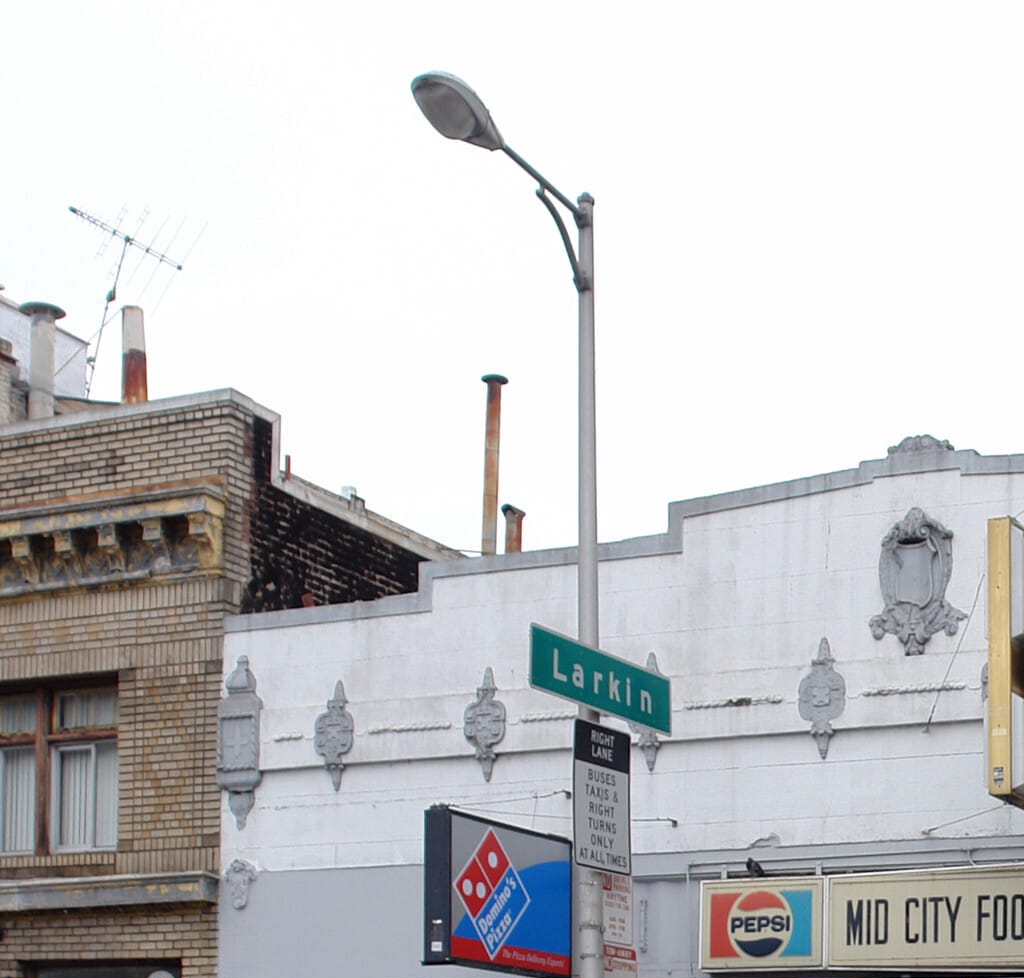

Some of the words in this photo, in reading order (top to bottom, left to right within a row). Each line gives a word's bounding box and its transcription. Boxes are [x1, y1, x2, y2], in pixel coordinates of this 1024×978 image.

[552, 648, 653, 715] Larkin
[591, 730, 615, 746] RIGHT
[592, 744, 614, 762] LANE
[588, 768, 616, 787] BUSES
[585, 784, 610, 801] TAXIS
[612, 791, 619, 803] &
[588, 801, 615, 818] RIGHT
[588, 817, 617, 835] TURNS
[590, 833, 615, 849] ONLY
[579, 848, 588, 859] AT
[590, 850, 605, 865] ALL
[606, 853, 627, 868] TIMES
[478, 876, 517, 935] Domino's
[730, 915, 791, 934] PEPSI
[845, 899, 890, 945] MID
[904, 896, 963, 944] CITY
[486, 911, 513, 950] Pizza
